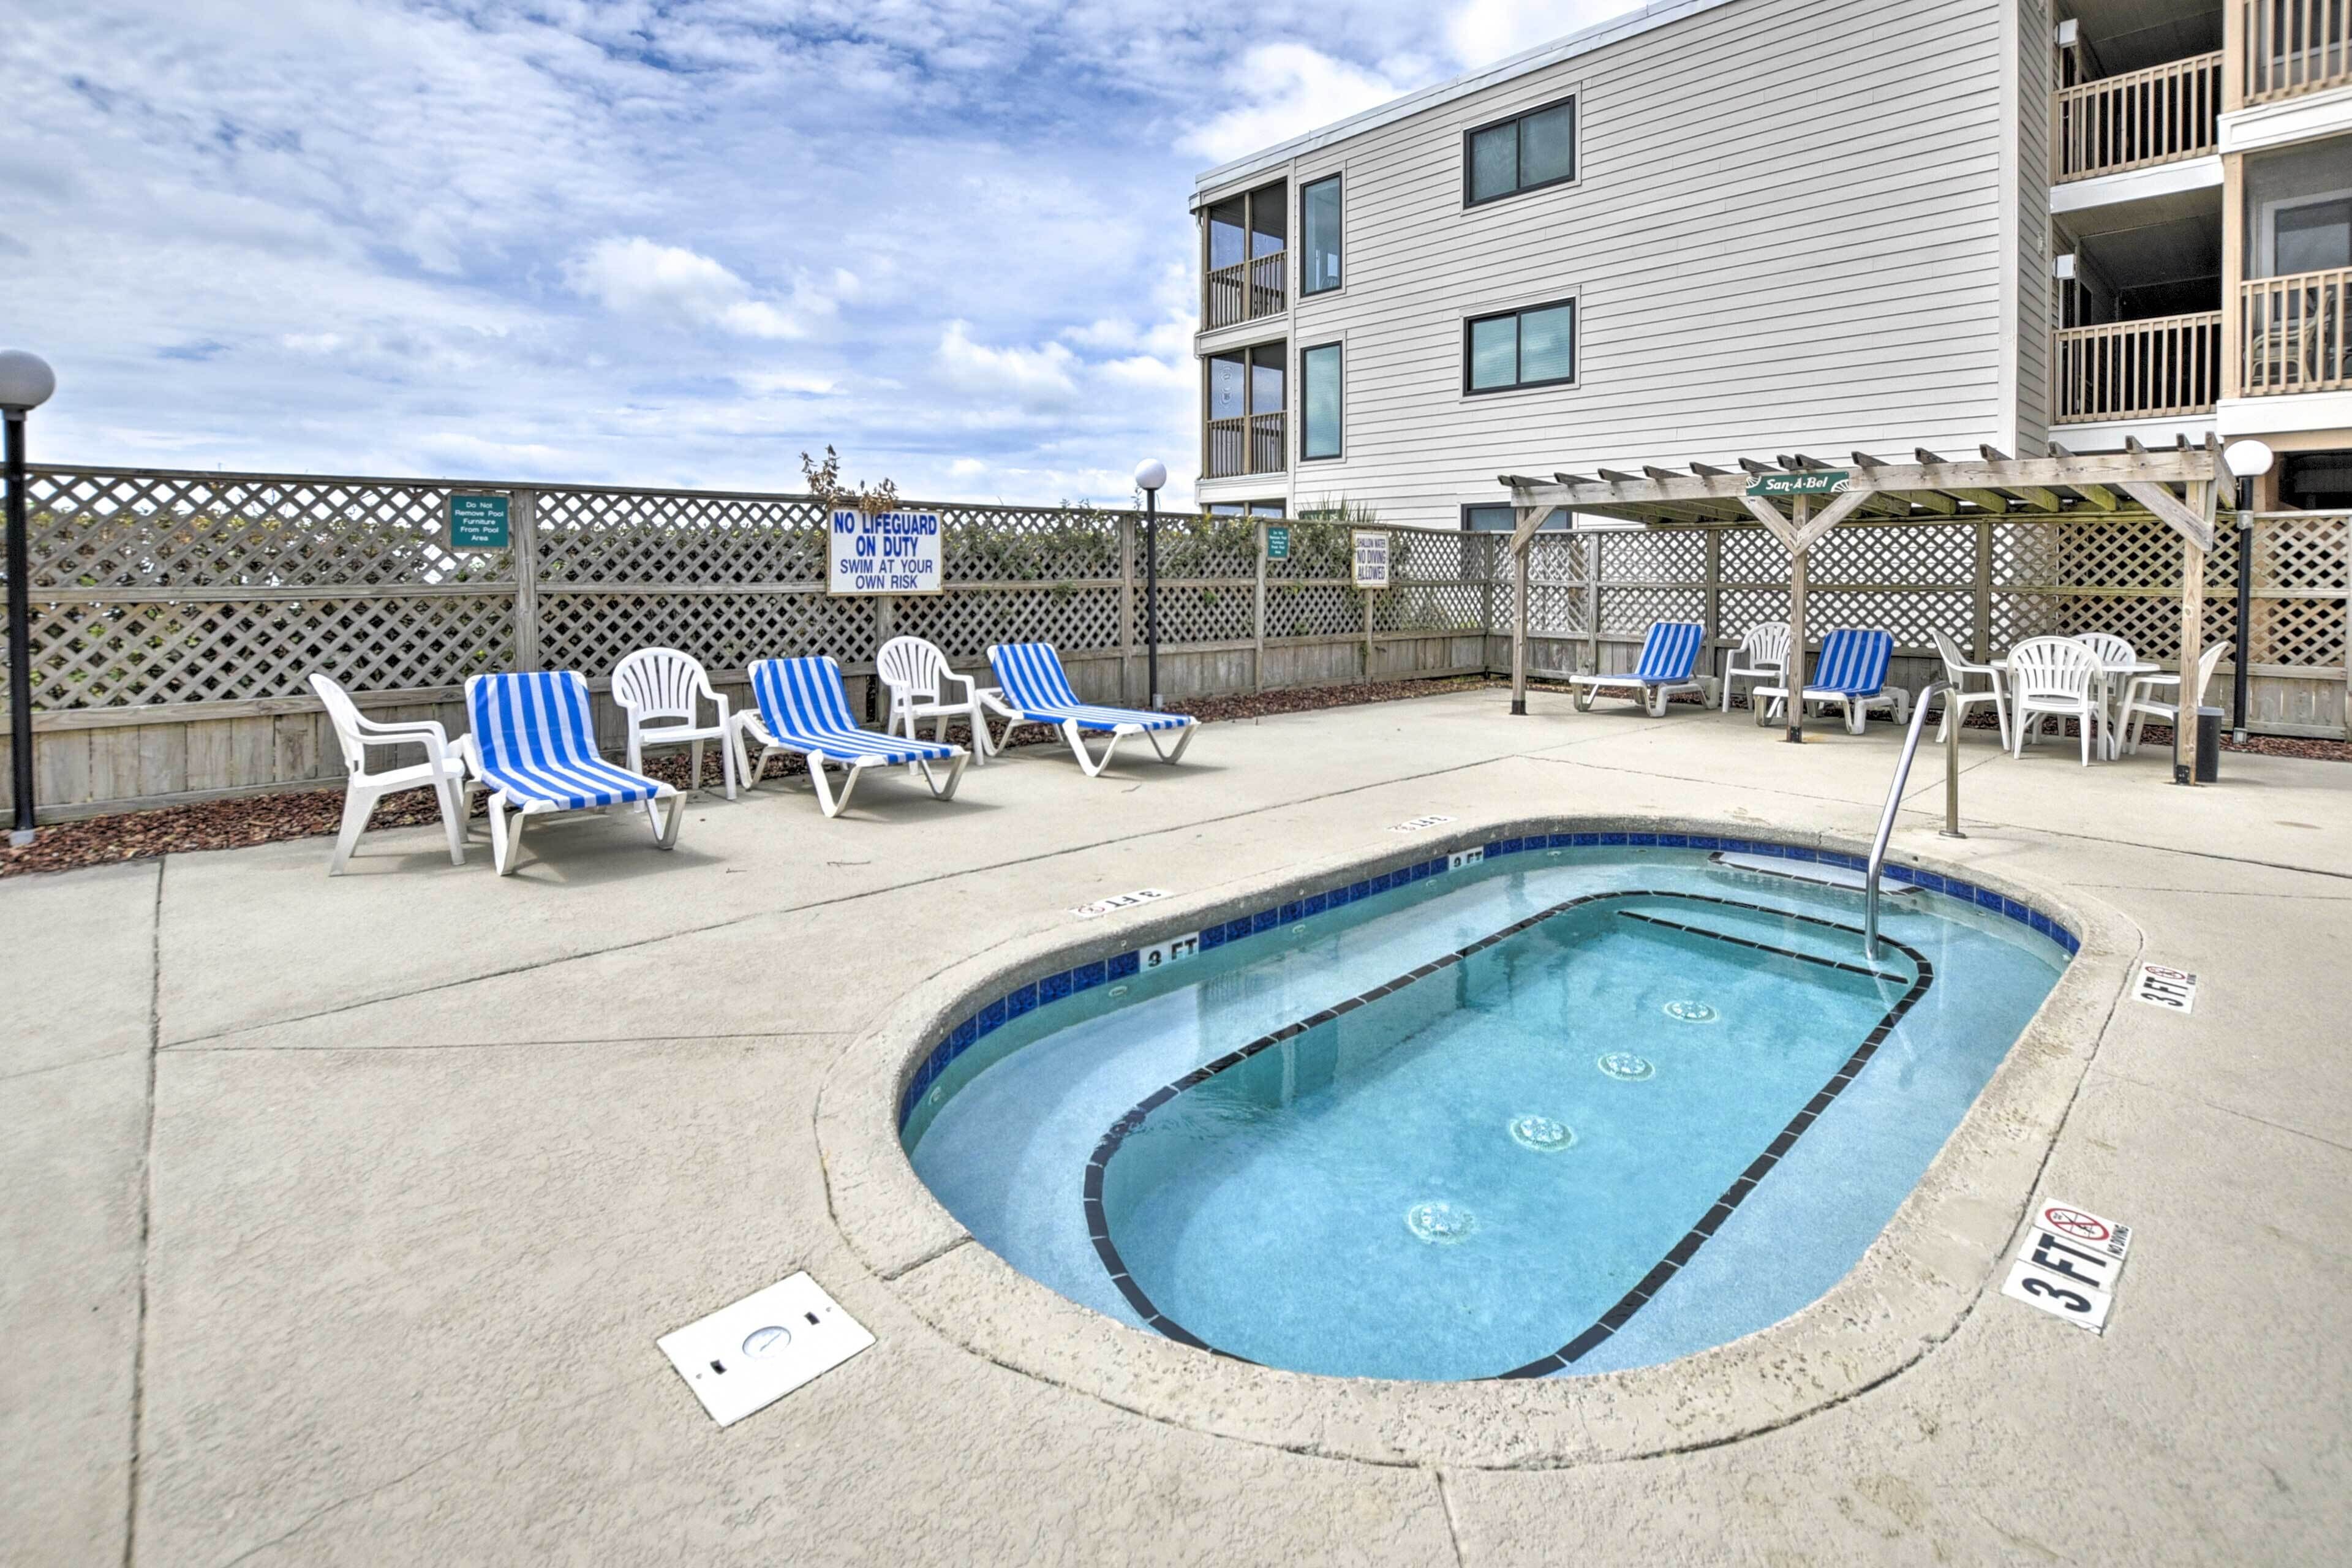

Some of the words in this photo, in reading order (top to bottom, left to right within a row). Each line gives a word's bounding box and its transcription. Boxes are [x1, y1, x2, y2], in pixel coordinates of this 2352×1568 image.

[834, 512, 855, 533] NO
[862, 513, 937, 535] LIFEGUARD
[856, 535, 876, 557] ON
[883, 537, 918, 557] DUTY
[1357, 549, 1365, 564] NO
[1367, 549, 1386, 564] DIVING
[840, 559, 873, 573] SWIM
[879, 559, 894, 573] AT
[901, 559, 933, 573] YOUR
[1357, 565, 1385, 580] ALLOWED
[856, 575, 884, 589] OWN
[891, 575, 918, 589] RISK
[1171, 937, 1197, 961] FT
[2143, 976, 2188, 997] FT
[2140, 992, 2184, 1007] 3
[2031, 1232, 2108, 1289] FT
[2021, 1278, 2092, 1313] 3
